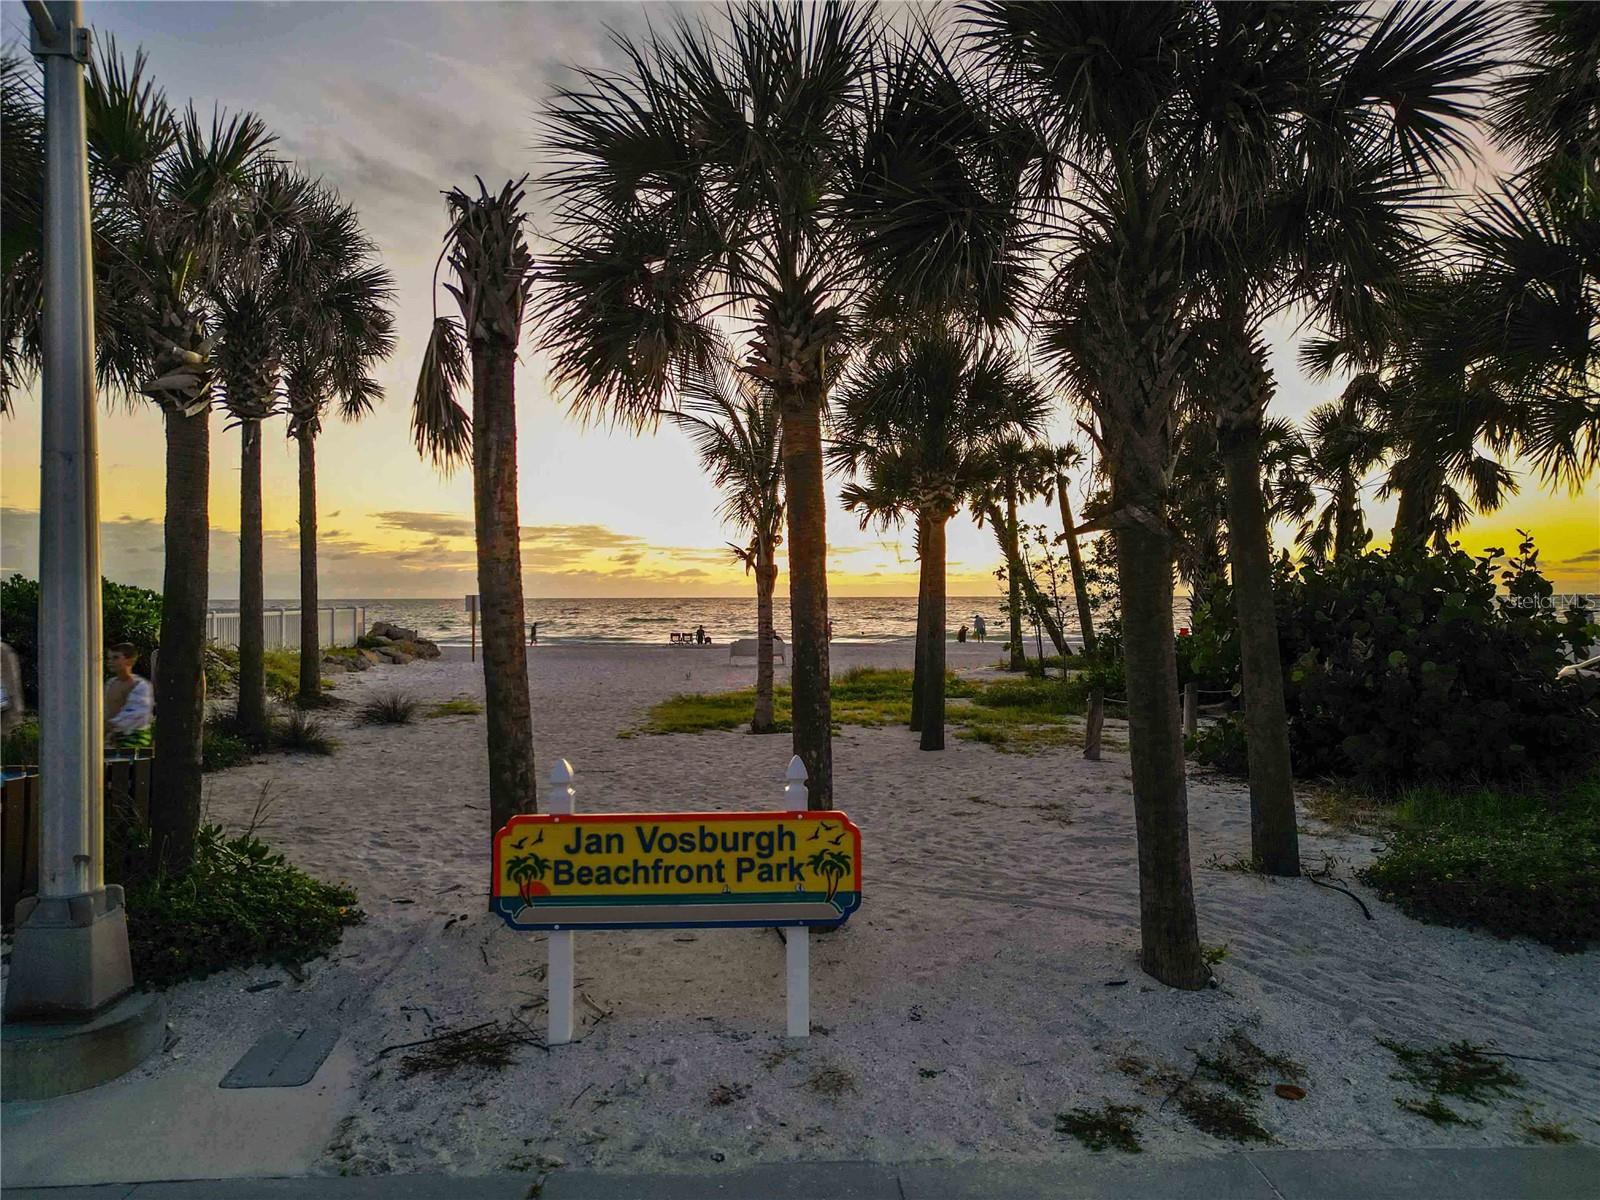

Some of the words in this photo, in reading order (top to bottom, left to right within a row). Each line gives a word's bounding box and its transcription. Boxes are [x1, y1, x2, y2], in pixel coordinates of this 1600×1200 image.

[564, 827, 624, 854] Jan
[635, 824, 796, 858] Vosburgh
[553, 858, 726, 885] Beachfront
[736, 856, 806, 882] Park
